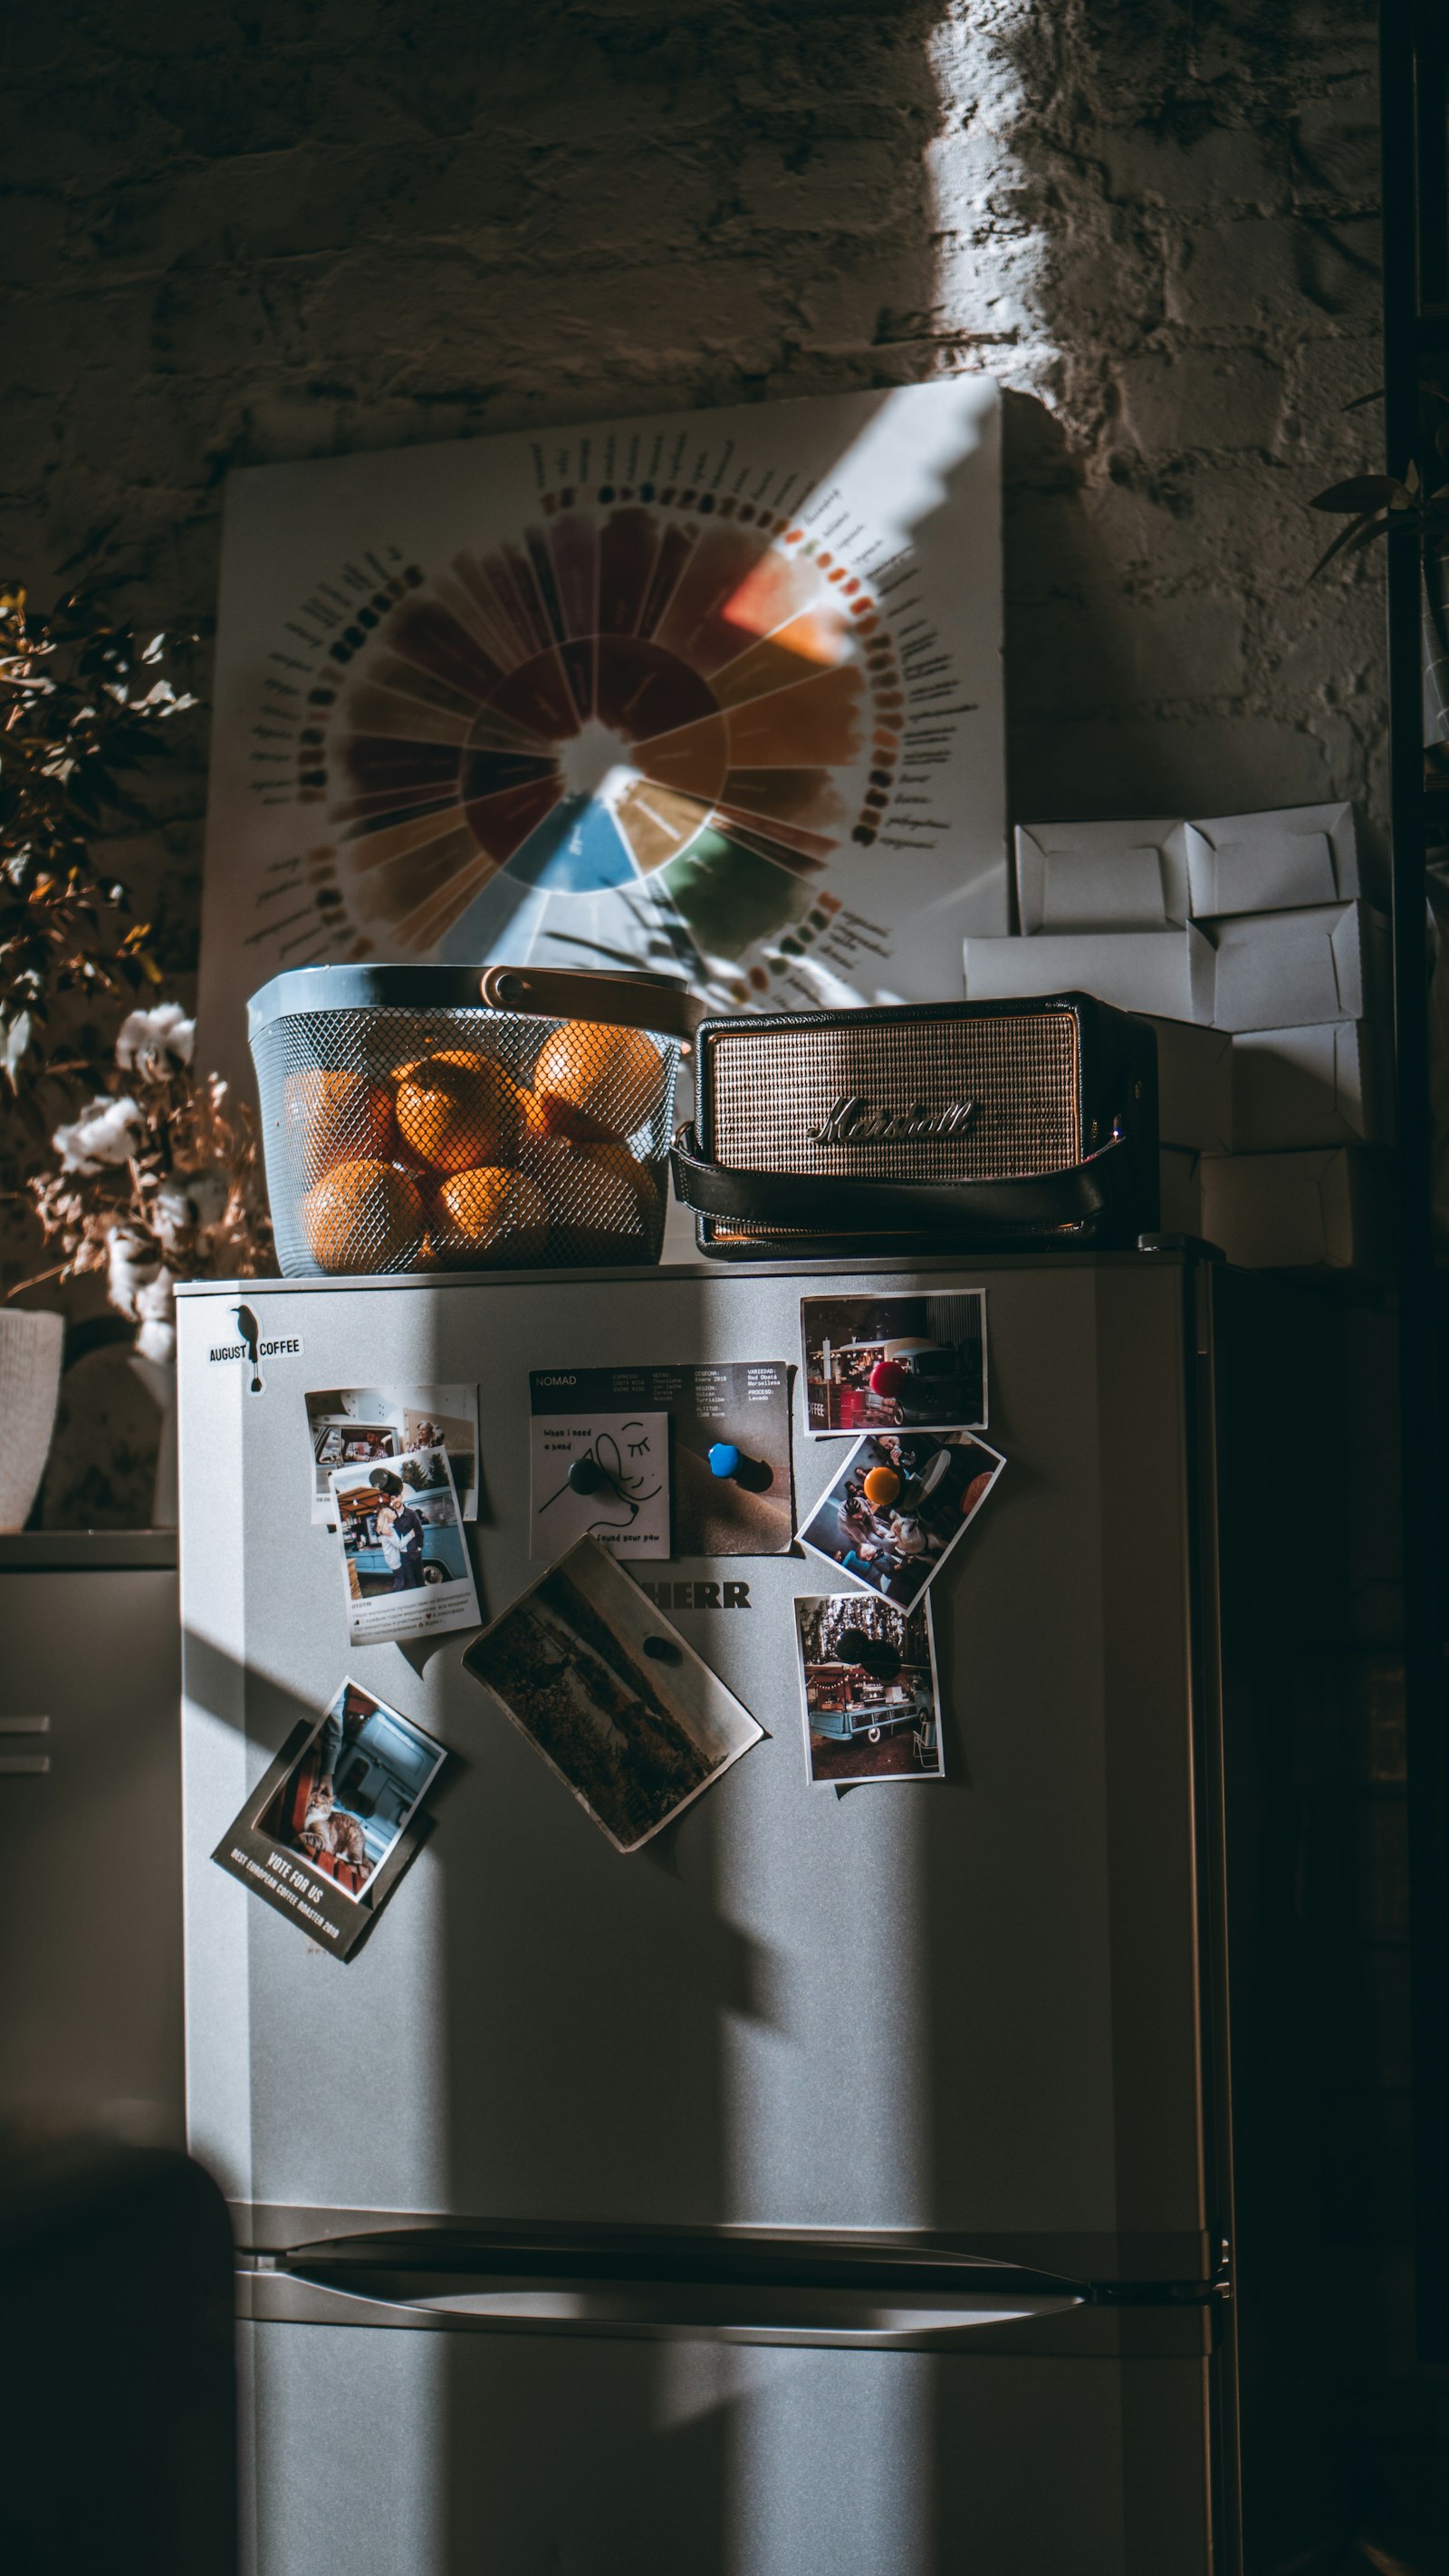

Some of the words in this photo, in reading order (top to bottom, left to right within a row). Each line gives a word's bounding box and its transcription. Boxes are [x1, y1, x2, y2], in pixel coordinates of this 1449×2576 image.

[807, 1096, 975, 1146] Marshall
[210, 1344, 246, 1362] AUGUST
[259, 1339, 300, 1356] COFFEE
[536, 1376, 576, 1386] NOMAD
[231, 1848, 249, 1867] BEST
[246, 1860, 278, 1889] EUROPEAN
[275, 1884, 299, 1907] COFFEE
[297, 1899, 325, 1926] ROASTER
[321, 1919, 340, 1939] 2019
[265, 1851, 293, 1879] VOTE
[288, 1870, 311, 1893] FOR
[307, 1885, 324, 1904] US
